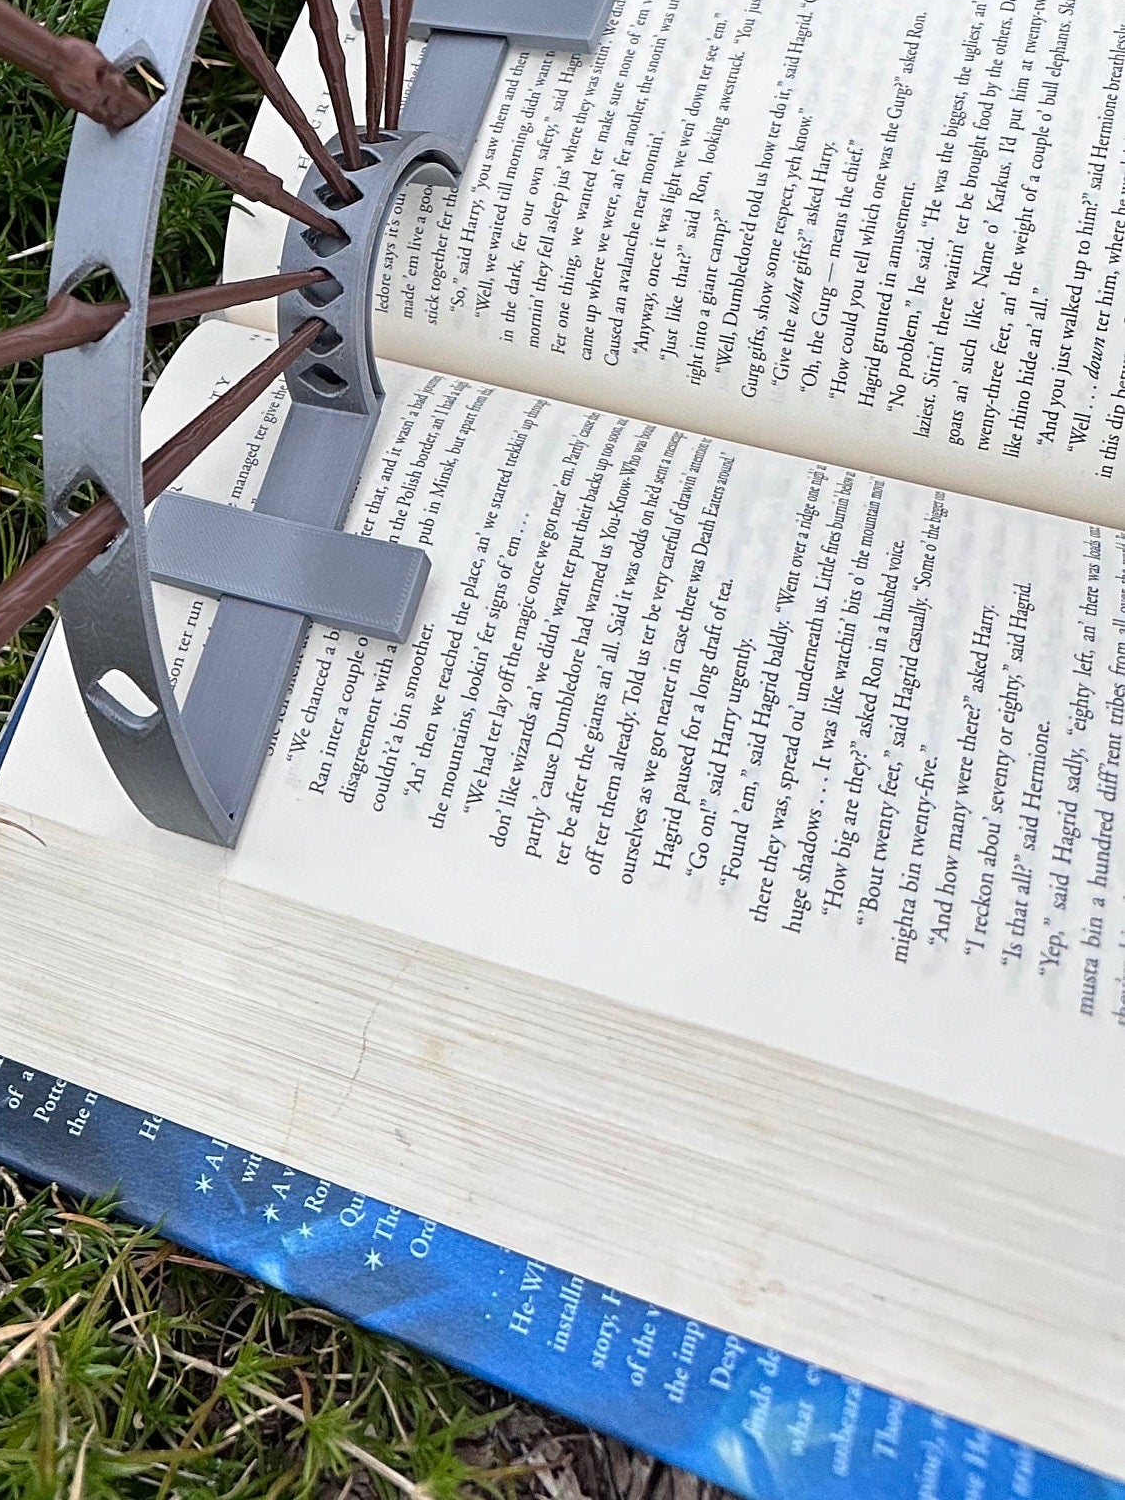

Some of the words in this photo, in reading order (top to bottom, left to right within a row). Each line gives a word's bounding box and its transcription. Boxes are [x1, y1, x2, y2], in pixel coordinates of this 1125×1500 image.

[971, 0, 987, 18] an'
[733, 18, 756, 44] "You
[961, 22, 984, 62] ugliest,
[509, 52, 530, 76] then
[953, 66, 972, 86] the
[504, 79, 520, 101] and
[719, 51, 745, 112] awestruck.
[489, 103, 511, 134] them
[940, 91, 969, 138] biggest,
[1090, 93, 1118, 159] Hermione
[485, 136, 499, 161] saw
[697, 116, 730, 164] looking
[935, 142, 955, 163] the
[841, 139, 864, 183] chief."
[1087, 162, 1106, 191] said
[470, 164, 492, 193] "you
[688, 171, 713, 204] Ron,
[934, 169, 949, 193] was
[834, 186, 854, 208] the
[921, 199, 943, 227] "He
[384, 219, 401, 239] it's
[436, 210, 453, 231] fer
[460, 199, 485, 243] Harry,
[683, 209, 701, 239] said
[888, 182, 916, 269] amusement.
[1075, 192, 1099, 237] him?"
[829, 212, 848, 259] means
[1077, 240, 1091, 255] to
[383, 242, 399, 270] says
[430, 233, 449, 291] together
[456, 246, 473, 276] said
[671, 244, 692, 288] that?"
[916, 237, 935, 270] said.
[1073, 260, 1093, 280] up
[374, 273, 392, 314] ledore
[449, 277, 468, 312] "So,"
[878, 273, 897, 288] in
[907, 275, 927, 295] he
[424, 294, 440, 326] stick
[664, 295, 684, 323] like
[811, 285, 838, 326] Gurg
[1060, 284, 1083, 340] walked
[872, 291, 893, 354] grunted
[659, 328, 679, 361] "Just
[806, 330, 825, 355] the
[896, 299, 922, 380] problem,"
[799, 360, 823, 392] "Oh,
[1051, 343, 1073, 377] just
[270, 385, 289, 400] the
[857, 355, 883, 408] Hagrid
[886, 384, 907, 412] "No
[1049, 378, 1067, 409] you
[260, 401, 282, 423] give
[1036, 409, 1060, 445] "And
[252, 423, 271, 441] ter
[228, 443, 261, 500] managed
[599, 454, 642, 540] You-Know-Who
[499, 536, 522, 559] 'em
[600, 543, 614, 559] us
[885, 540, 906, 571] voice.
[496, 560, 513, 580] of
[585, 560, 609, 613] warned
[485, 582, 509, 620] signs
[717, 579, 734, 602] tea.
[872, 573, 899, 623] hushed
[1008, 582, 1036, 631] Hagrid.
[1078, 586, 1099, 617] there
[176, 630, 193, 652] ter
[186, 600, 204, 628] run
[709, 600, 727, 621] of
[476, 621, 497, 644] fer
[570, 615, 594, 646] had
[699, 623, 723, 661] draft
[868, 637, 888, 653] in
[877, 625, 890, 634] a
[1006, 632, 1026, 663] said
[1072, 650, 1096, 677] left,
[342, 650, 365, 703] couple
[460, 646, 489, 702] lookin'
[689, 663, 719, 700] long
[861, 657, 885, 690] Ron
[286, 728, 311, 762] "We
[300, 658, 332, 724] chanced
[325, 646, 336, 656] a
[545, 648, 586, 750] Dumbledore
[693, 704, 705, 714] a
[997, 663, 1026, 724] eighty,"
[337, 706, 349, 716] a
[373, 735, 404, 812] couldn't'a
[389, 703, 412, 730] bin
[404, 623, 435, 699] smoother.
[854, 691, 878, 739] asked
[319, 717, 345, 758] inter
[680, 715, 702, 742] for
[999, 726, 1014, 746] or
[441, 707, 477, 799] mountains,
[843, 740, 872, 794] they?"
[308, 762, 333, 795] Ran
[532, 753, 560, 800] 'cause
[673, 744, 696, 806] paused
[991, 749, 1016, 814] seventy
[1062, 748, 1089, 793] sadly,
[427, 802, 449, 829] the
[844, 799, 859, 826] are
[910, 744, 938, 857] twenty-five."
[525, 806, 551, 860] partly
[652, 806, 683, 870] Hagrid
[830, 829, 860, 859] big
[977, 816, 1001, 868] abou'
[1051, 799, 1082, 865] Hagrid
[1086, 809, 1115, 889] hundred
[821, 862, 848, 916] "How
[898, 862, 922, 893] bin
[1049, 871, 1070, 910] said
[970, 873, 995, 935] reckon
[1092, 897, 1105, 908] a
[891, 898, 918, 964] mighta
[964, 938, 985, 955] "I
[1080, 917, 1103, 948] bin
[1080, 958, 1099, 1017] musta
[7, 1084, 25, 1108] of
[21, 1069, 35, 1080] a
[66, 1107, 91, 1135] the
[204, 1154, 224, 1171] A
[271, 1182, 292, 1199] A
[589, 1312, 621, 1369] story,
[632, 1320, 657, 1357] the
[626, 1353, 647, 1386] of
[664, 1365, 690, 1402] the
